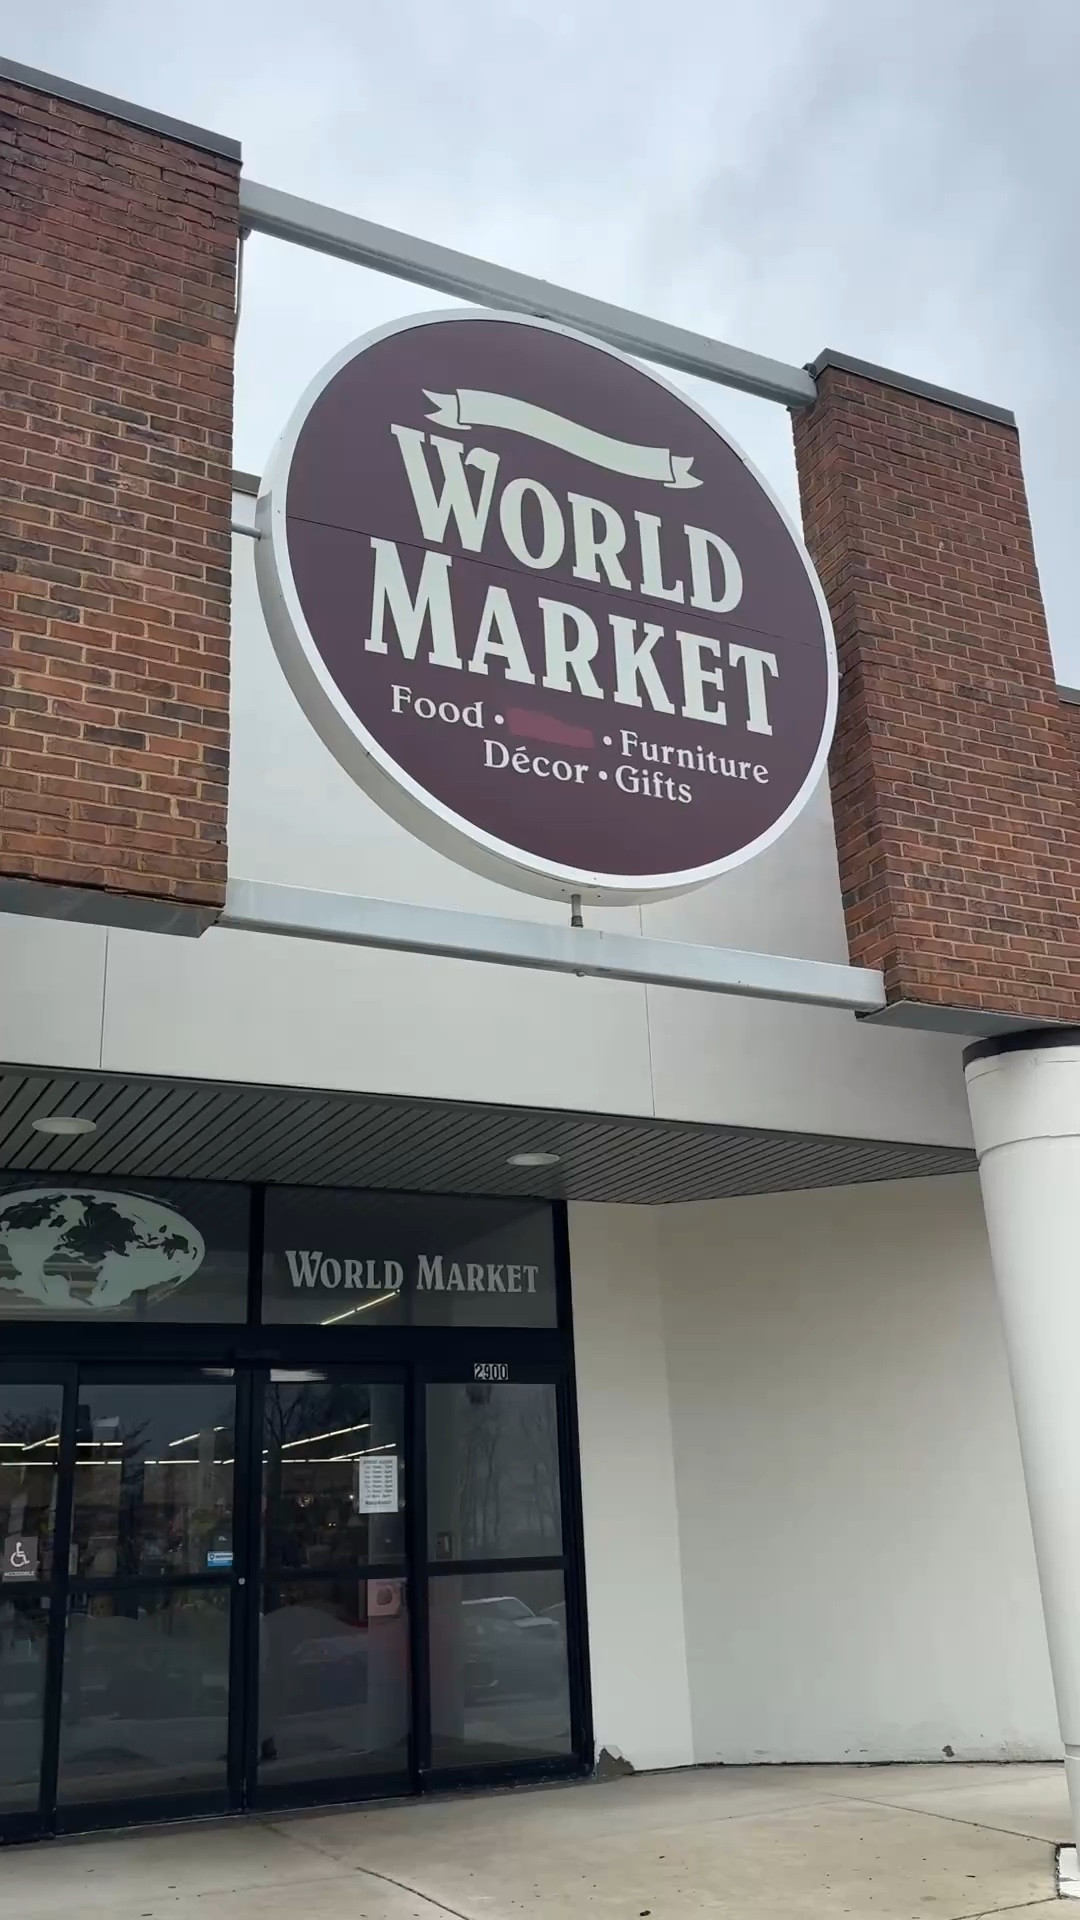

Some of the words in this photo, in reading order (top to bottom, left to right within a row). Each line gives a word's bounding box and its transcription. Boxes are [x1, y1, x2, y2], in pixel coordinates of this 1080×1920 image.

[391, 423, 744, 613] WORLD
[364, 536, 779, 736] MARKET
[391, 684, 485, 729] Food
[619, 729, 769, 784] Furniture
[484, 739, 589, 784] Décor
[615, 764, 693, 804] Gifts
[285, 1250, 404, 1289] WORLD
[416, 1254, 539, 1293] MARKET
[474, 1363, 508, 1380] 2900
